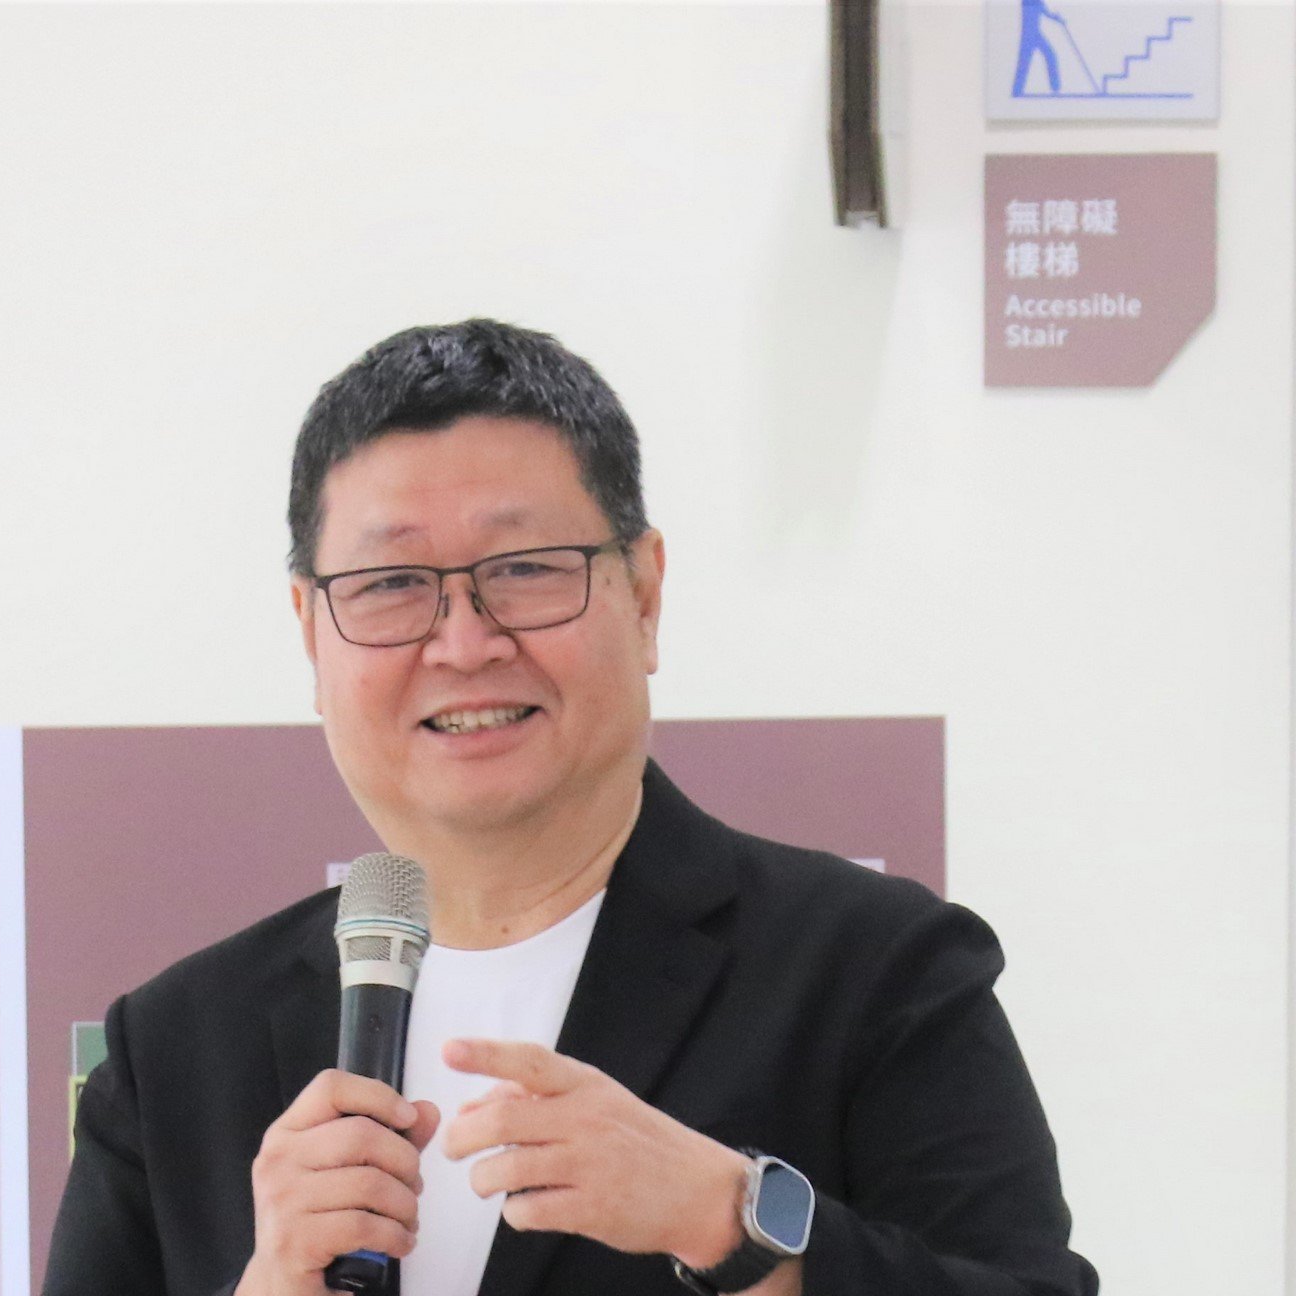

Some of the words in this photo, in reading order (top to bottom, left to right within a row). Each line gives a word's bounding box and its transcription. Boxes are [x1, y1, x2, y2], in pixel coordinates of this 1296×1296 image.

[1006, 199, 1117, 235] 無障礙
[1005, 242, 1079, 278] 樓梯
[1004, 293, 1141, 318] Accessible
[1005, 324, 1068, 348] Stair
